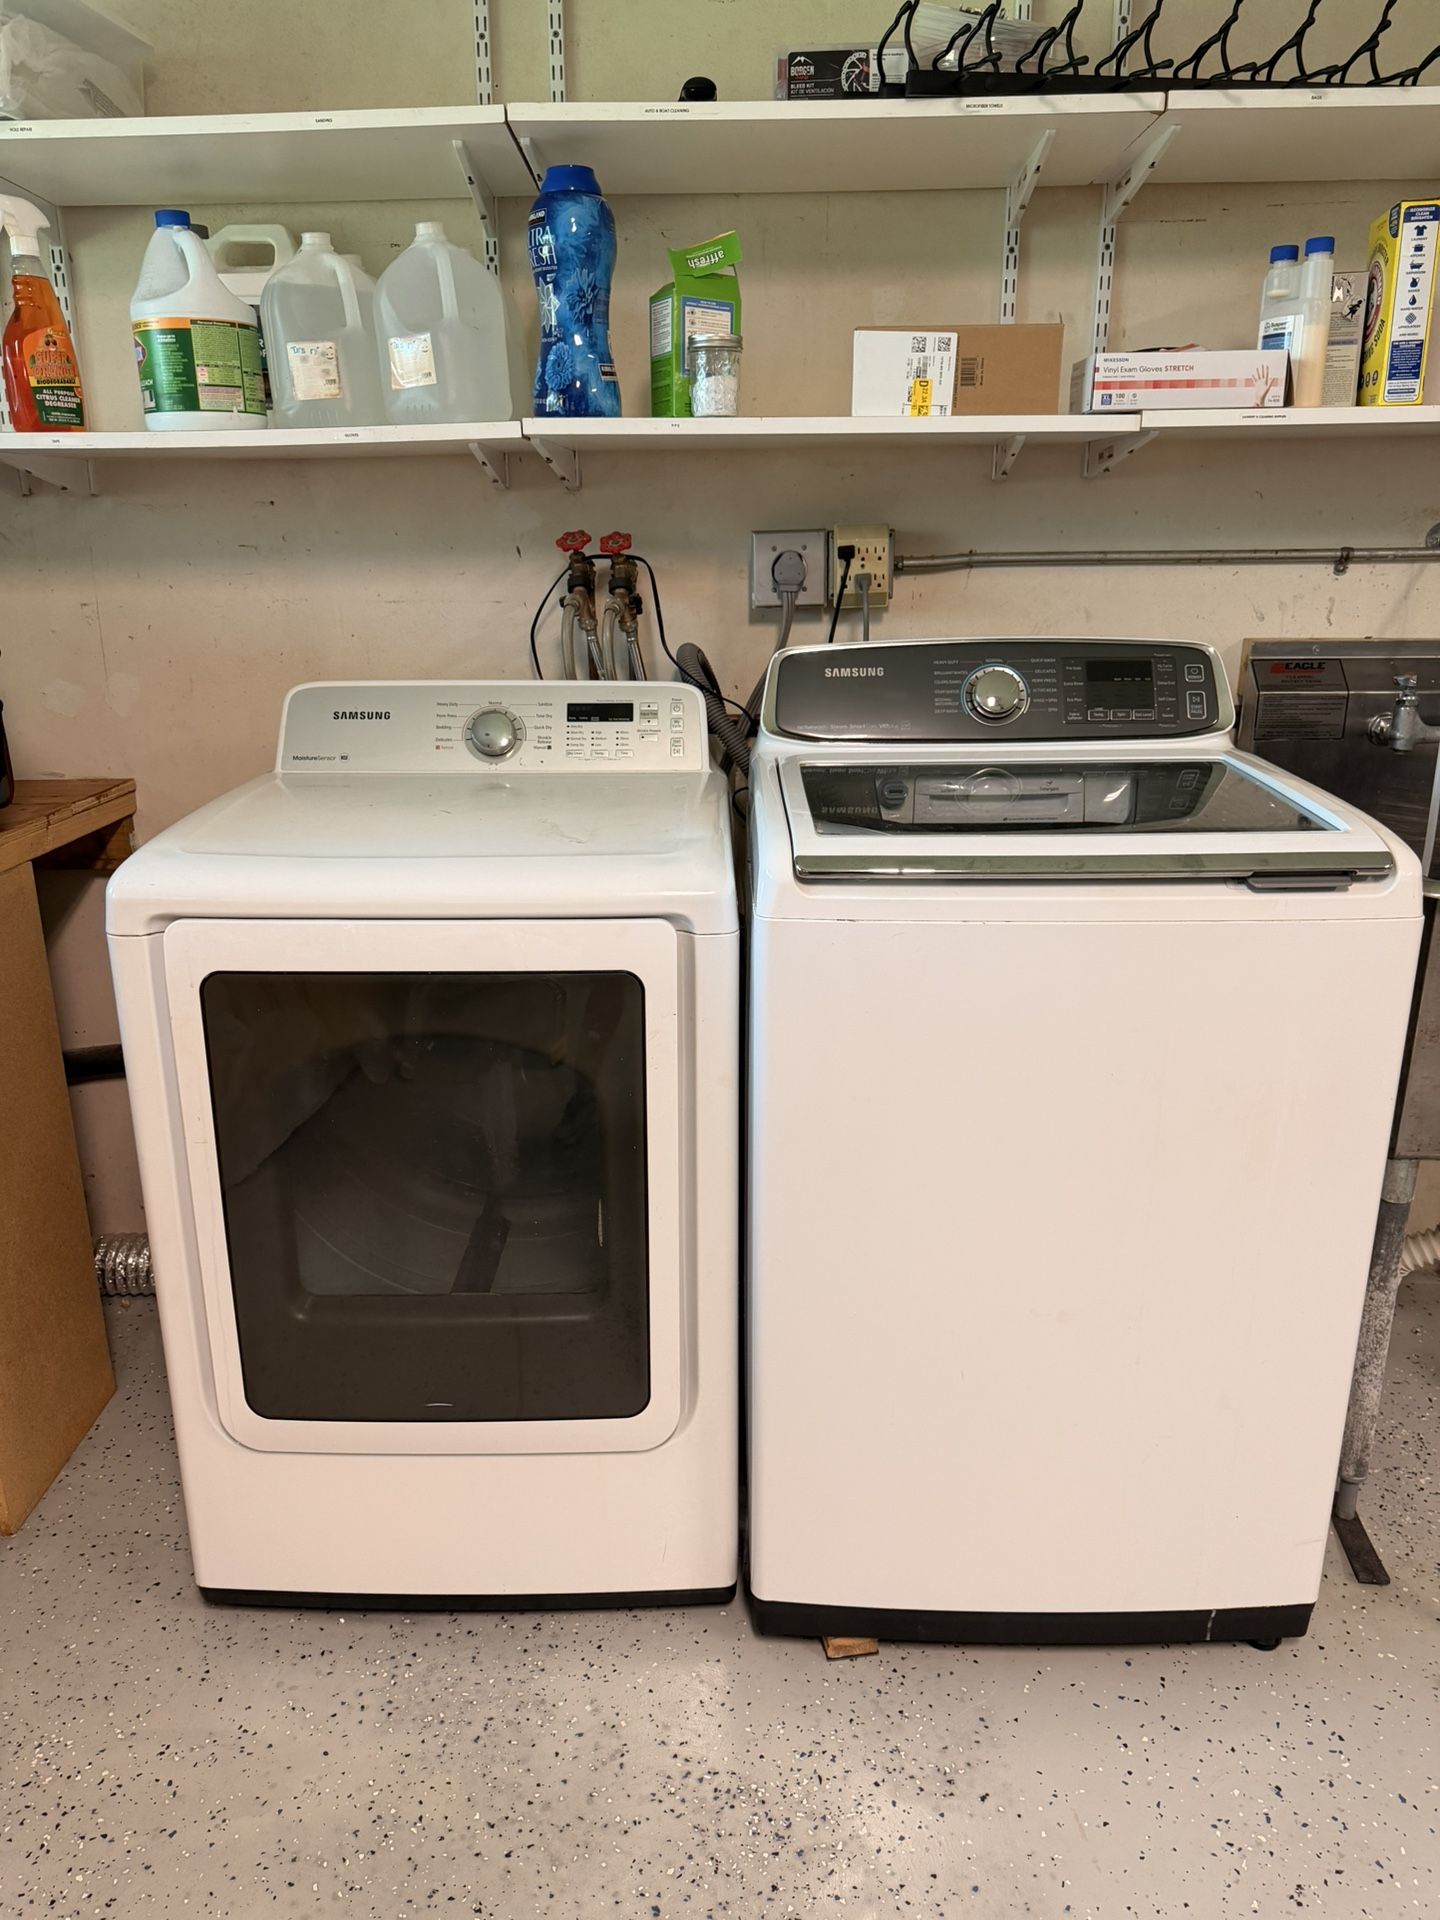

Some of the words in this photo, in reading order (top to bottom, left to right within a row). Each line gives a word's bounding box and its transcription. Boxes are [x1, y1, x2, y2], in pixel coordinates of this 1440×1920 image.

[688, 250, 724, 269] affresh
[45, 400, 76, 408] DEGREASER
[824, 667, 884, 678] SAMSUNG
[333, 711, 391, 720] SAMSUNG
